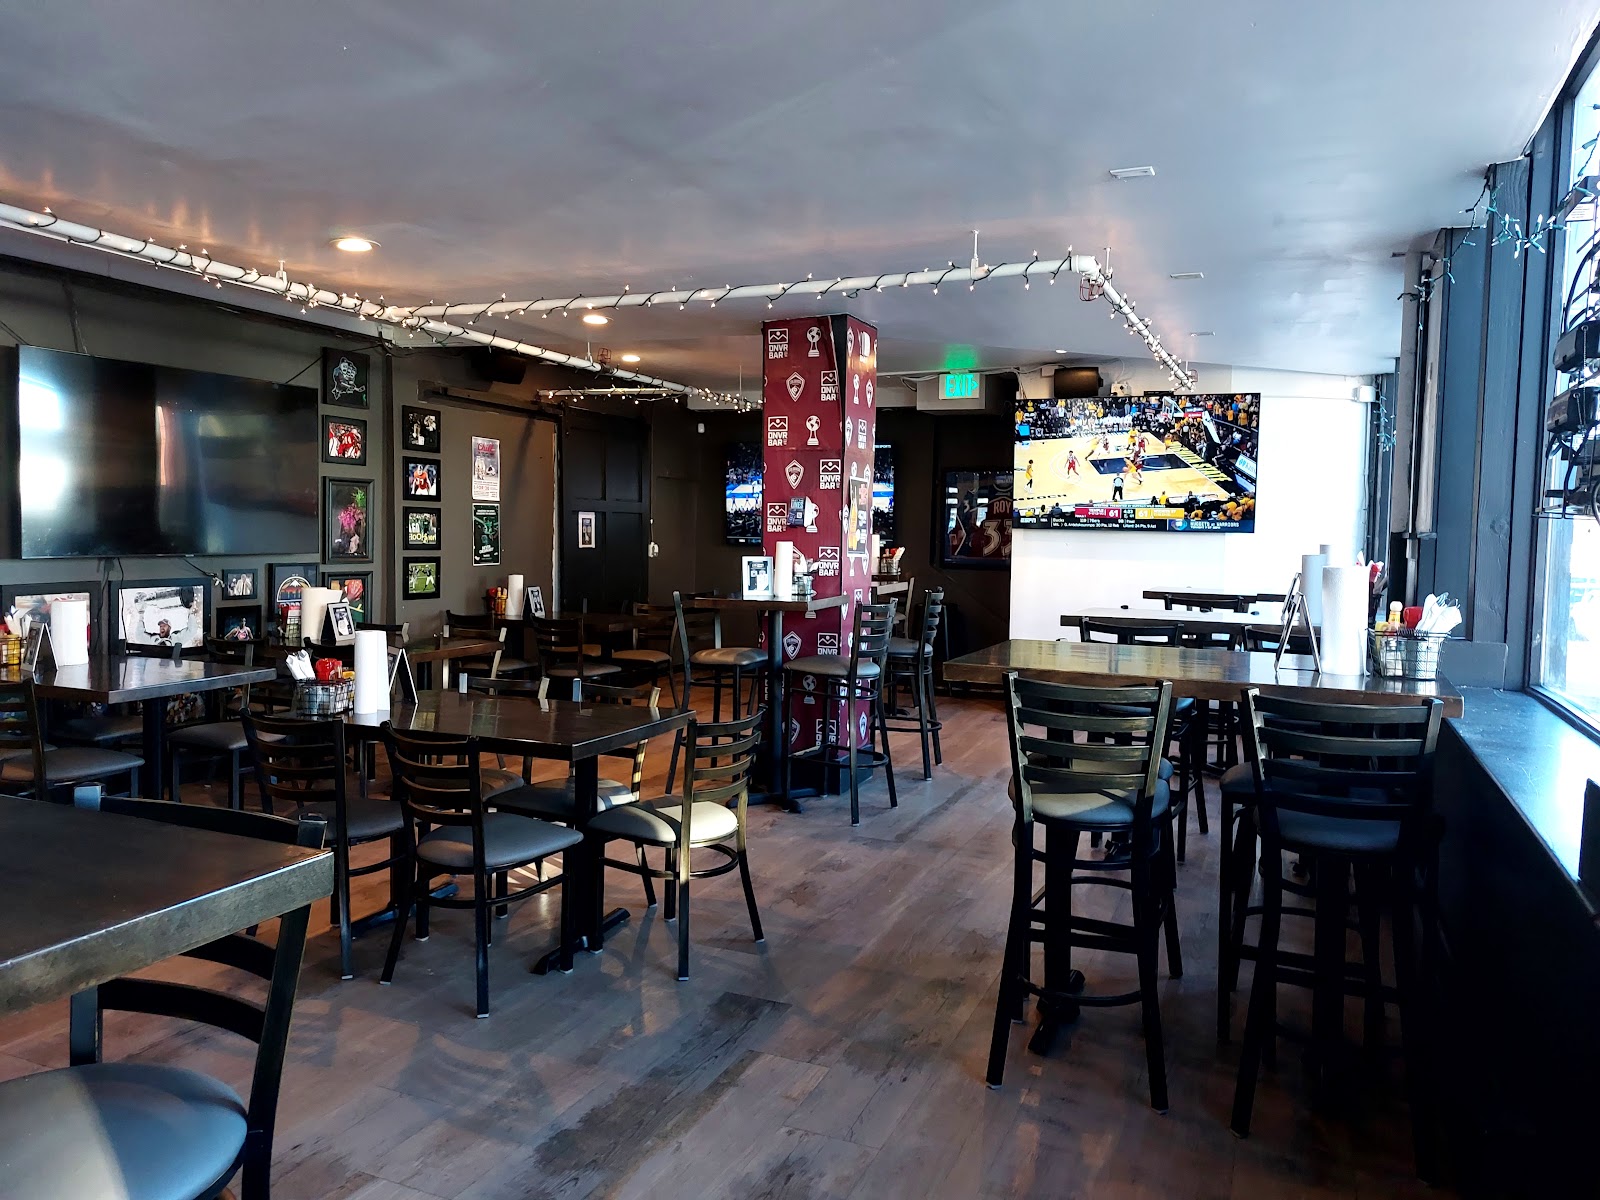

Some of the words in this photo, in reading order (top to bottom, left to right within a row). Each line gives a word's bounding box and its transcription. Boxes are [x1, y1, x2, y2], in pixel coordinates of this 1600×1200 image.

[768, 344, 788, 352] DNVR
[945, 374, 973, 397] EXIT
[820, 482, 836, 490] BAR
[819, 561, 840, 570] DNVR
[818, 647, 838, 655] DNVR
